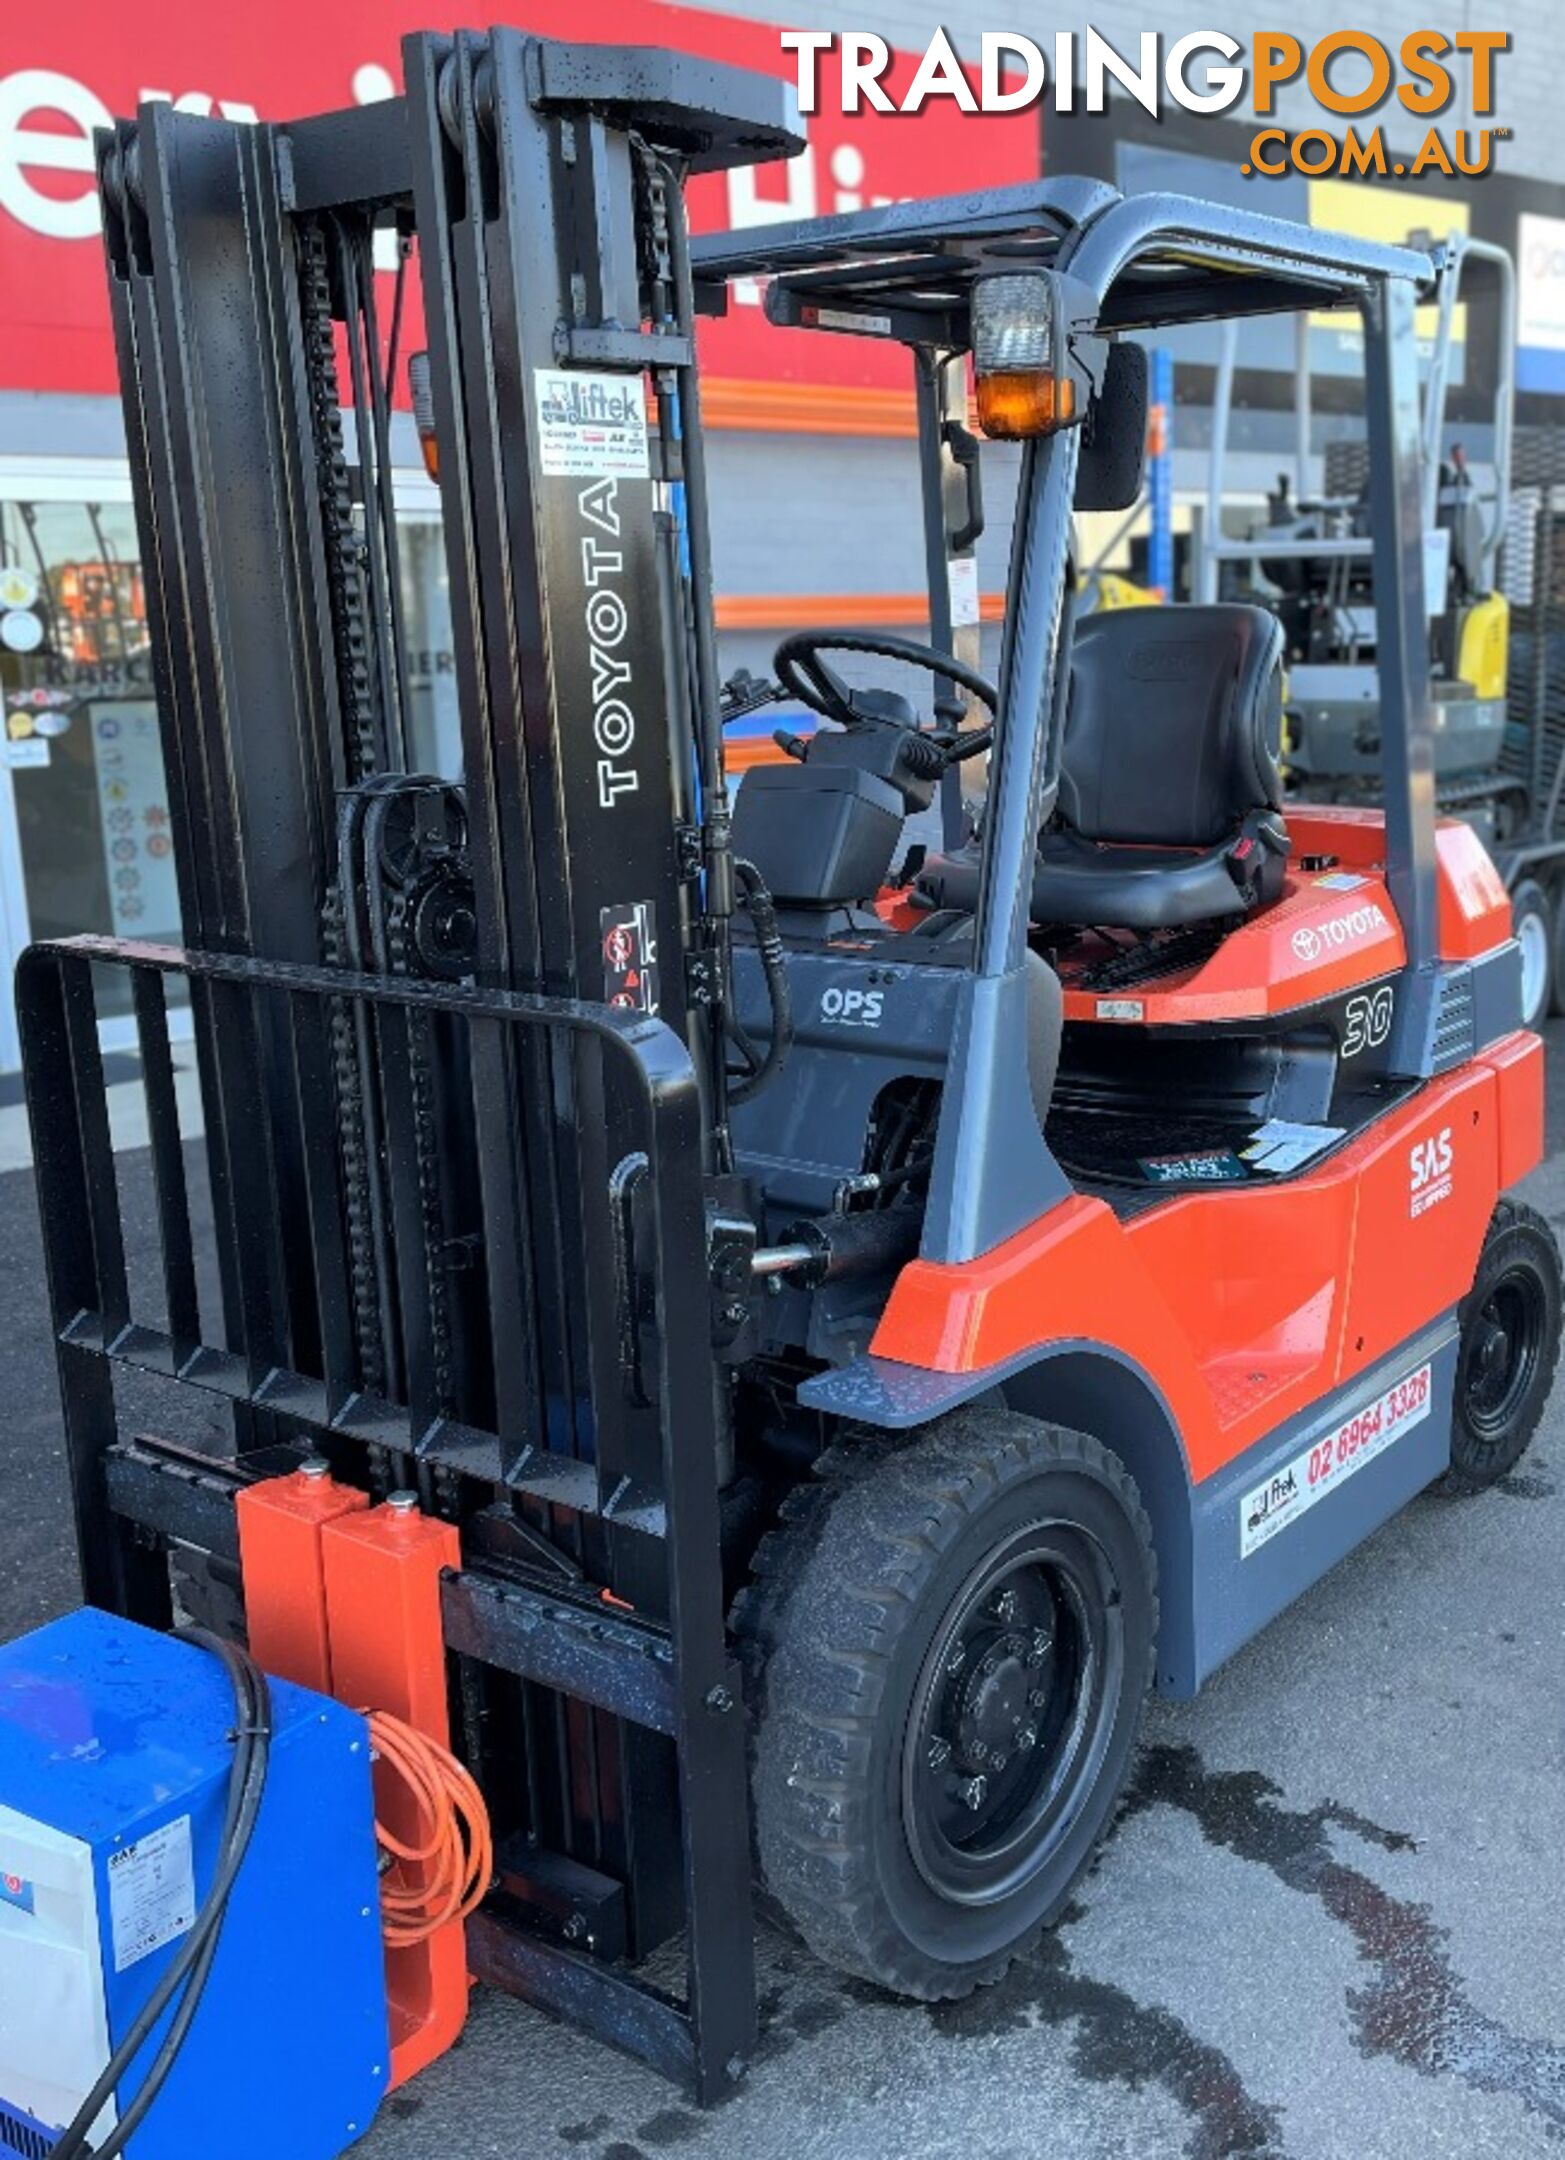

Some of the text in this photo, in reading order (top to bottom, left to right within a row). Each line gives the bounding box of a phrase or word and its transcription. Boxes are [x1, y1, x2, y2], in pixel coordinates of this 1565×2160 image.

[579, 477, 639, 807] TOYOTA
[1317, 904, 1389, 948] TOYOTA
[821, 988, 884, 1018] OPS
[1341, 986, 1393, 1058] 30
[1411, 1127, 1452, 1191] SAS
[1307, 1439, 1333, 1486] 02
[1336, 1401, 1382, 1463] 6964
[1387, 1369, 1429, 1426] 3328
